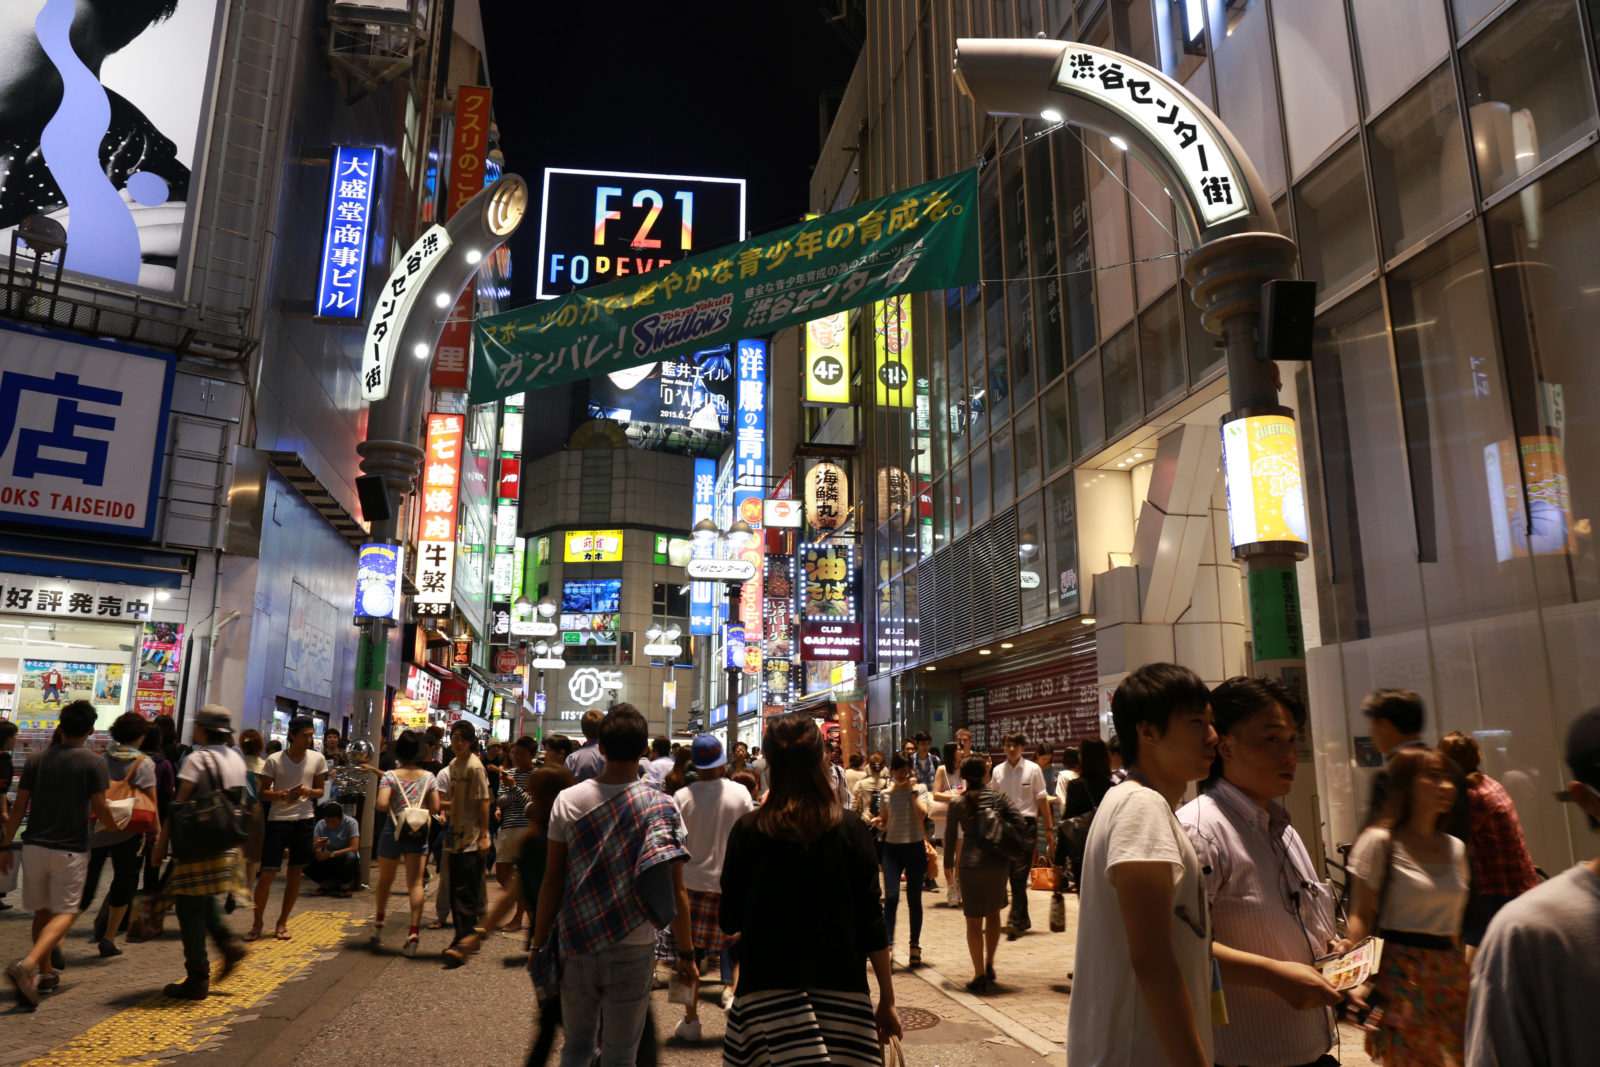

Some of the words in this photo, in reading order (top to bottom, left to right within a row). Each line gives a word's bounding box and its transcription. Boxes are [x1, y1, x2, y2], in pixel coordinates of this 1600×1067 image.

[1069, 53, 1234, 206] 渋谷センター街
[325, 156, 369, 309] 大盛堂商事ビル
[594, 186, 694, 250] F21
[550, 254, 673, 285] FOREV
[662, 307, 695, 322] Tokyo
[695, 294, 732, 313] Yakult
[743, 252, 922, 329] 渋谷センター街
[365, 233, 438, 393] 渋谷センター街
[633, 307, 732, 357] Swallows
[661, 360, 730, 382] 藍井エイル
[813, 359, 841, 380] 4F
[0, 370, 124, 487] 店
[736, 347, 765, 491] 洋服の青山
[51, 492, 136, 520] TAISEIDO
[424, 438, 457, 540] 七輪焼肉
[422, 544, 448, 593] 牛繁
[805, 548, 847, 581] 油
[0, 584, 150, 620] 好評発売中
[805, 581, 848, 601] そば
[767, 601, 779, 641] ハンバーグ
[778, 601, 789, 640] ステーキ&
[821, 626, 842, 634] CLUB
[803, 636, 827, 646] GAS
[827, 637, 860, 646] PANIC
[448, 710, 462, 720] Tax
